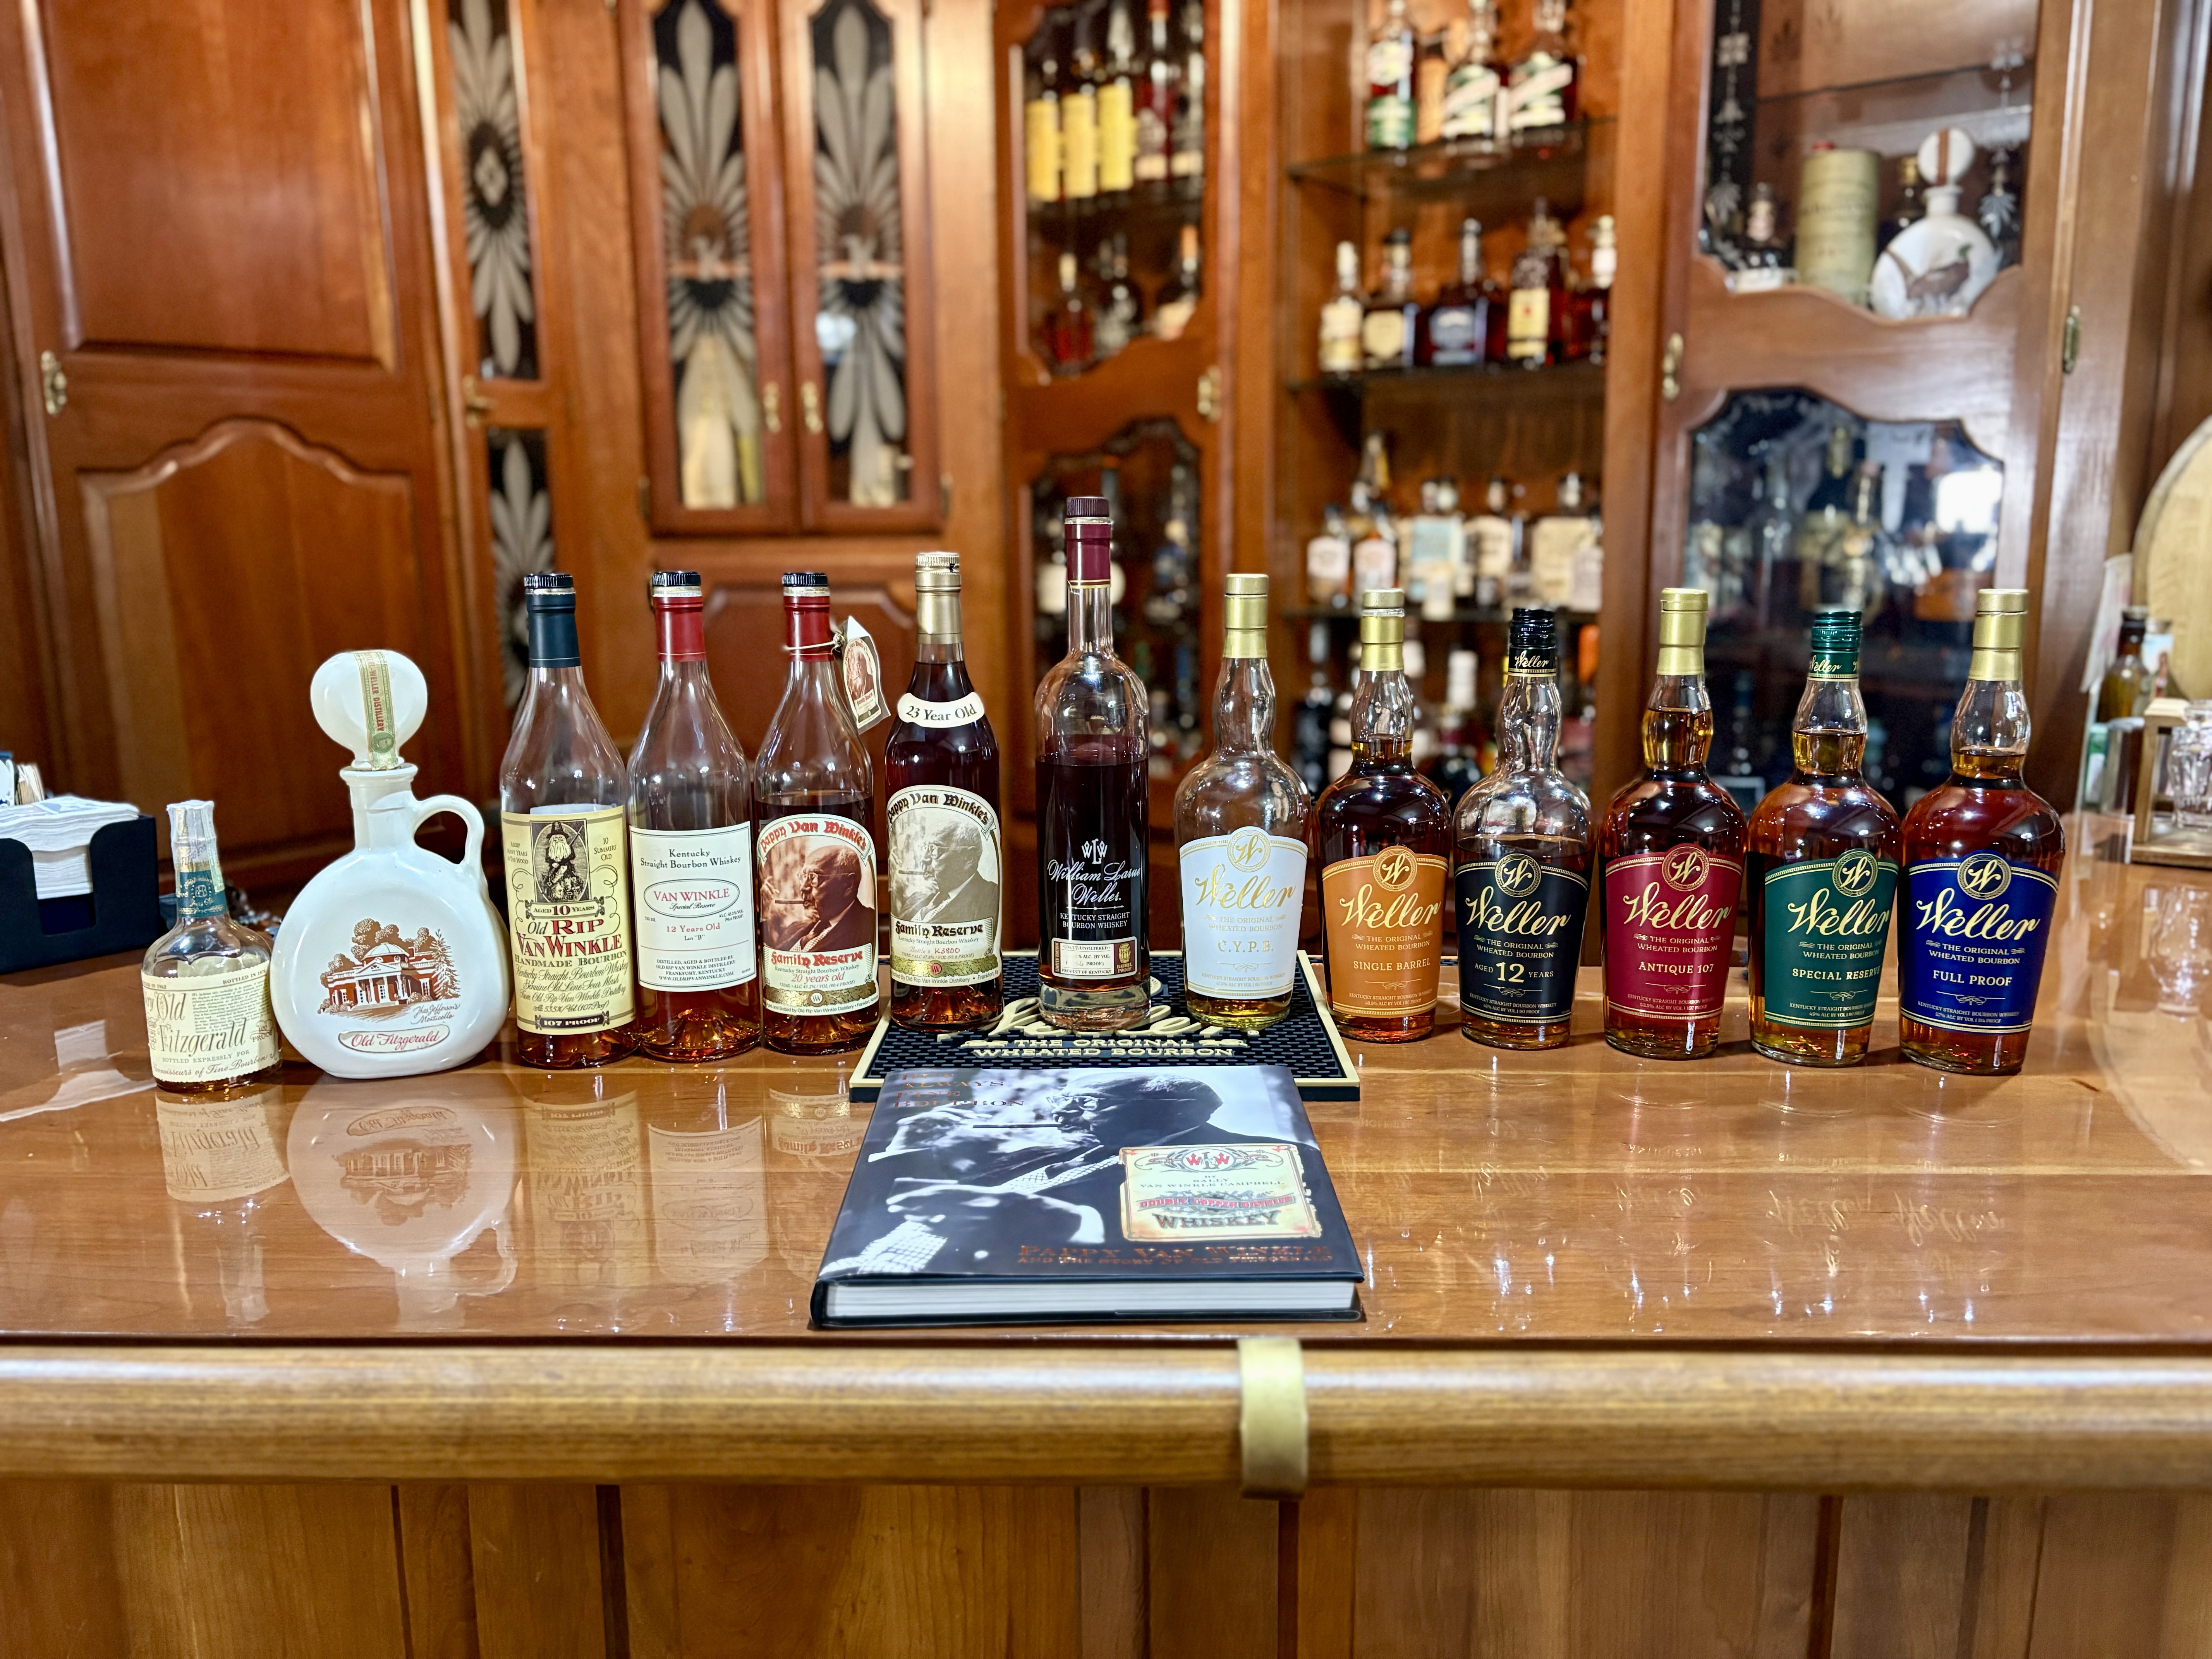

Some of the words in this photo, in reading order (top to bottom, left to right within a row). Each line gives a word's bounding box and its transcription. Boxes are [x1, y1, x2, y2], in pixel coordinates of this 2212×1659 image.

[1515, 650, 1550, 668] Weller
[373, 697, 384, 731] DISTILLERY
[906, 706, 920, 718] 23
[924, 709, 951, 720] Year
[955, 703, 977, 718] Old
[909, 793, 939, 805] Van
[943, 793, 989, 825] Winkle's
[788, 821, 819, 834] Van
[824, 821, 867, 851] Winkle's
[669, 848, 710, 857] Kentucky
[641, 858, 668, 869] Straight
[710, 856, 741, 866] Whiskey
[1047, 859, 1101, 882] William
[1195, 863, 1296, 909] Weller
[654, 891, 677, 902] VAN
[680, 888, 730, 901] WINKLE
[551, 905, 570, 915] 10
[670, 902, 693, 911] Special
[1339, 884, 1441, 929] Weller
[1465, 886, 1571, 936] Weller
[1623, 882, 1732, 929] Weller
[1787, 888, 1890, 936] Weller
[1098, 912, 1130, 921] STRAIGHT
[1916, 888, 2040, 940] Weller
[527, 921, 548, 935] Old
[551, 919, 604, 935] RIP
[895, 921, 930, 939] Family
[931, 924, 983, 937] Reserve
[516, 932, 545, 958] VAN
[543, 934, 622, 958] WINKLE
[1398, 940, 1430, 950] BOURBON
[1477, 945, 1513, 957] WHEATED
[1637, 943, 1680, 953] WHEATED
[1964, 947, 2009, 955] ORIGINAL
[515, 954, 572, 967] HANDMADE
[577, 950, 627, 966] BOURBON
[771, 951, 810, 969] Family
[812, 951, 863, 966] Reserve
[1803, 951, 1847, 959] WHEATED
[1929, 950, 1975, 962] WHEATED
[1353, 961, 1392, 971] SINGLE
[1396, 958, 1431, 970] BARREL
[1475, 963, 1494, 973] AGED
[1496, 962, 1525, 983] 12
[1638, 962, 1693, 975] ANTIQUE
[1697, 963, 1714, 973] 107
[223, 975, 249, 984] BOTTLED
[538, 969, 568, 984] Straight
[569, 965, 605, 980] Bourbon
[792, 974, 802, 982] 20
[804, 974, 829, 984] years
[832, 972, 845, 981] old
[1792, 969, 1841, 980] SPECIAL
[1933, 970, 1964, 983] FULL
[1970, 975, 2012, 986] PROOF
[155, 991, 186, 1021] Old
[411, 1012, 454, 1024] Monticello
[565, 1017, 600, 1025] PROOF
[157, 1017, 246, 1057] Fitzgerald
[351, 1034, 374, 1046] Old
[377, 1031, 439, 1050] Fitzgerald
[1014, 1039, 1063, 1048] THE
[1073, 1039, 1196, 1048] ORIGINAL
[194, 1054, 232, 1063] EXPRESSLY
[974, 1048, 1101, 1057] WHEATED
[1111, 1048, 1233, 1057] BOURBON
[195, 1067, 205, 1078] of
[206, 1063, 228, 1074] Fine
[229, 1054, 268, 1070] Bourbon
[1152, 1210, 1281, 1229] WHISKEY
[1133, 1248, 1194, 1258] VAN
